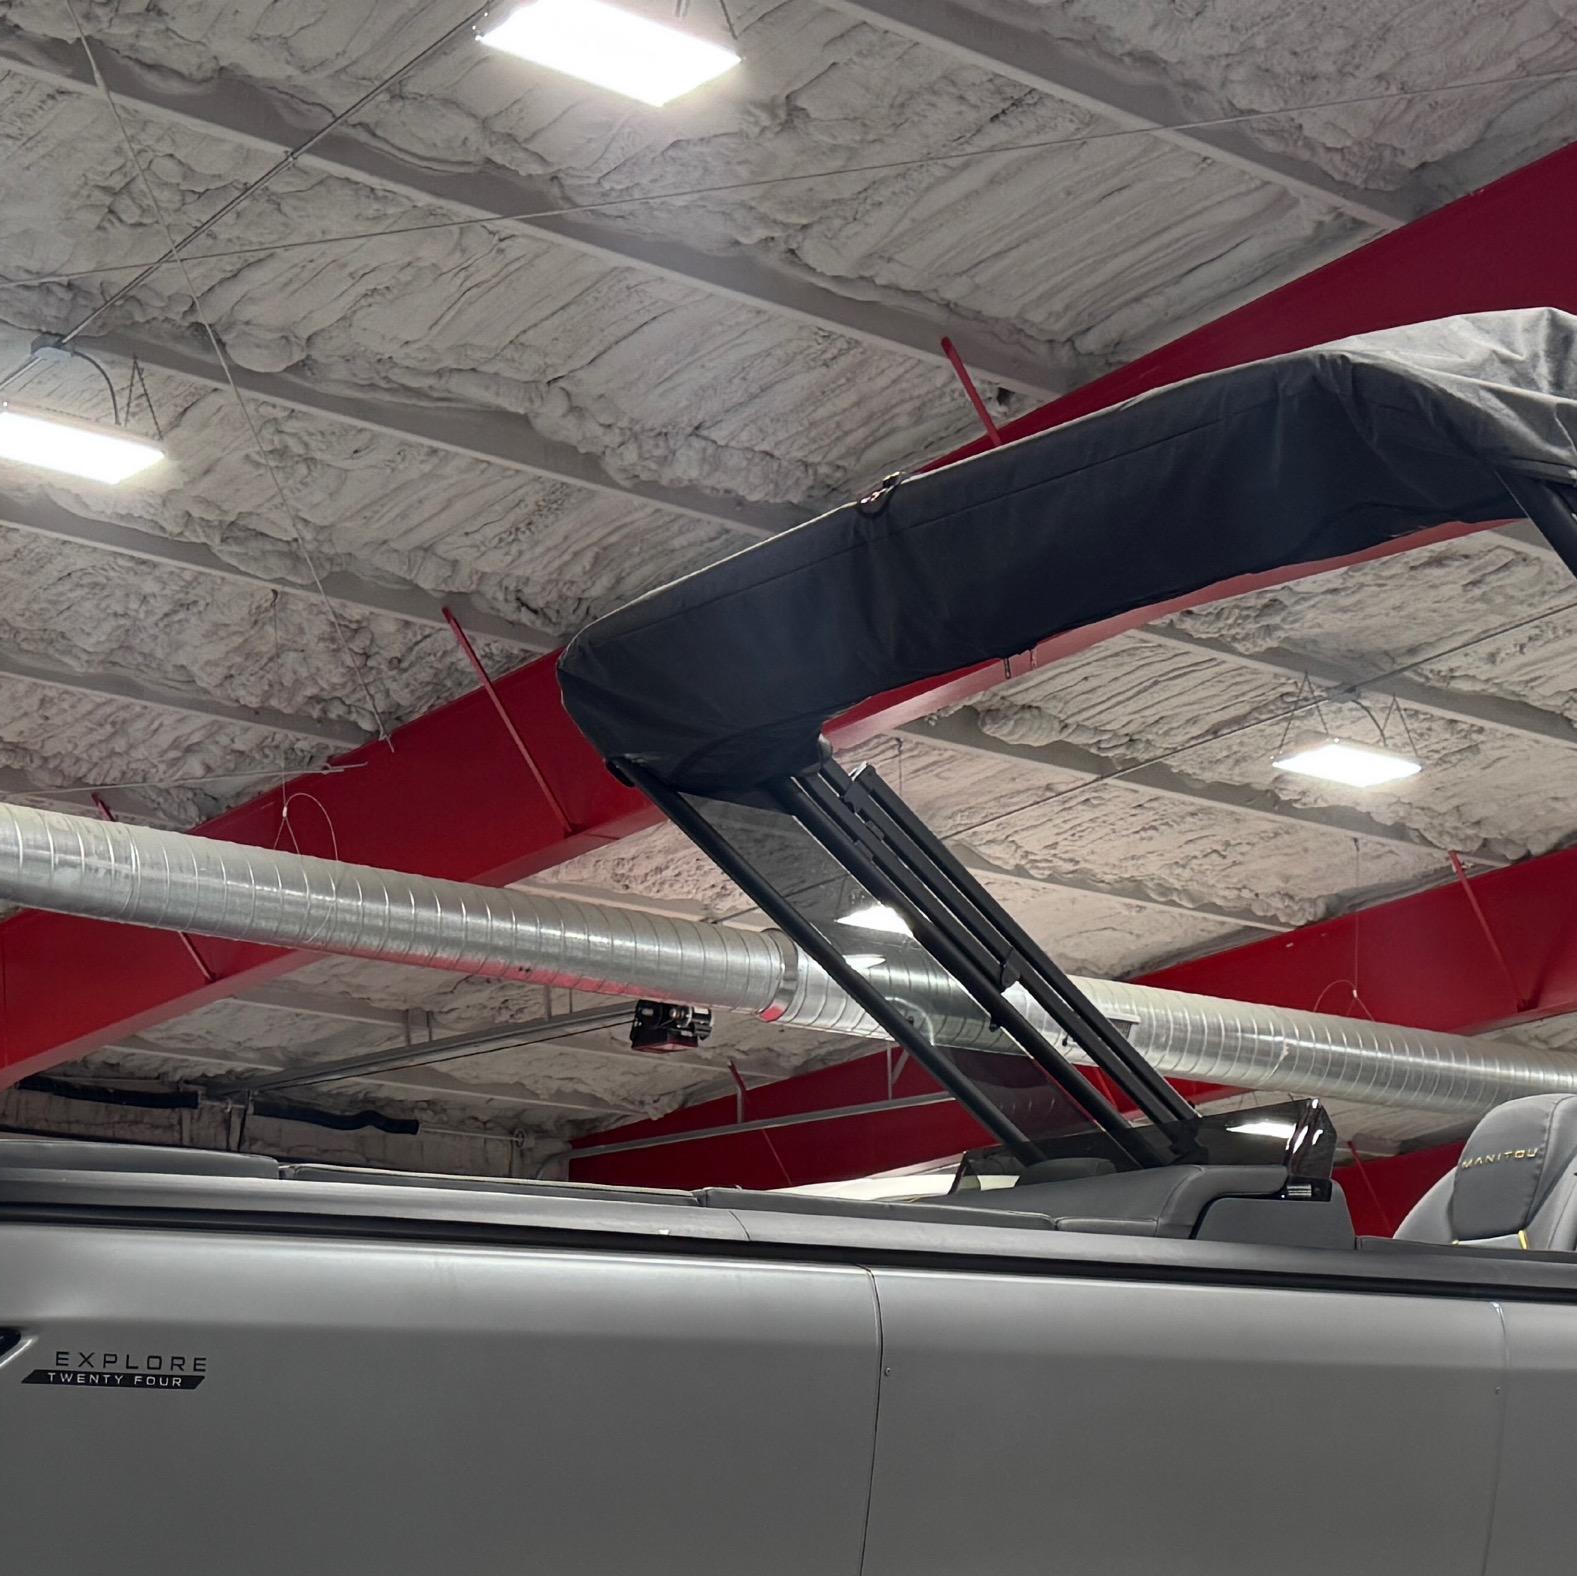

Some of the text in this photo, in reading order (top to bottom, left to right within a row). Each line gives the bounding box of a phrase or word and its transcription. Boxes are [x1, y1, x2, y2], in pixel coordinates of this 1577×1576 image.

[1461, 1147, 1539, 1168] MANITOU
[55, 1351, 207, 1372] EXPLORE
[47, 1372, 182, 1387] TWENTY FOUR
